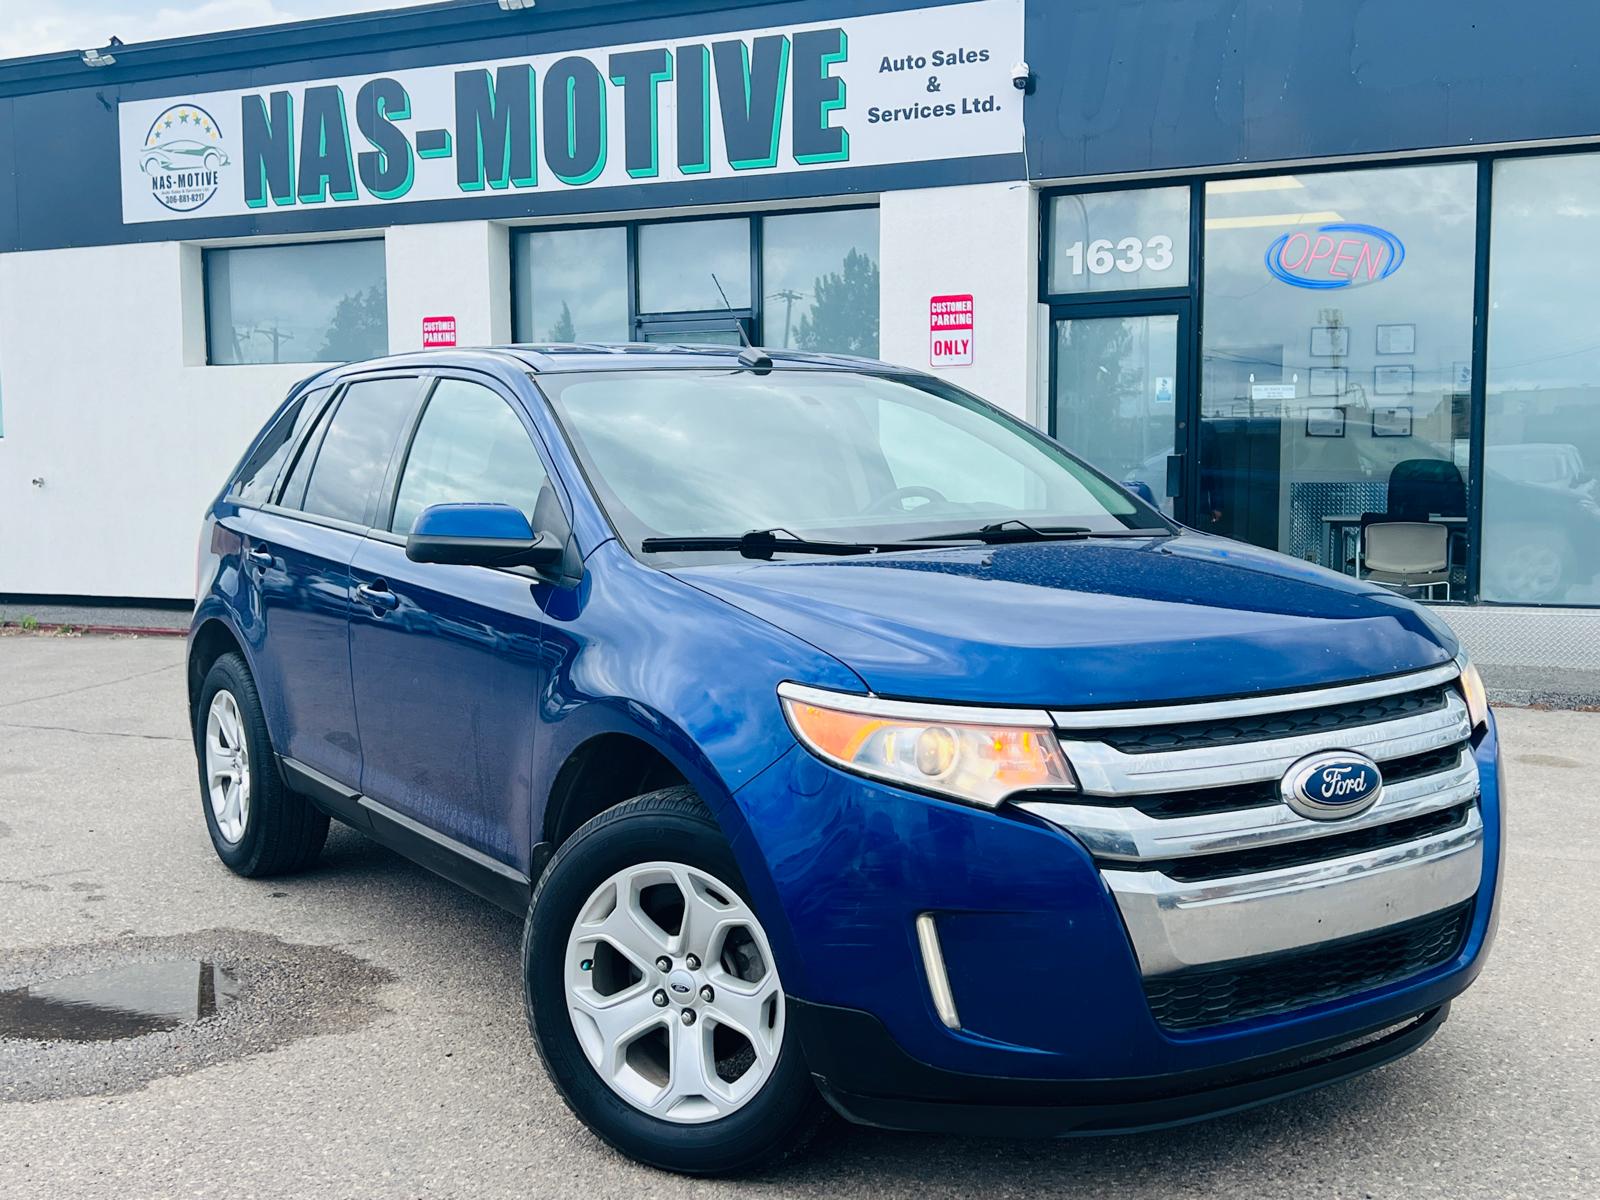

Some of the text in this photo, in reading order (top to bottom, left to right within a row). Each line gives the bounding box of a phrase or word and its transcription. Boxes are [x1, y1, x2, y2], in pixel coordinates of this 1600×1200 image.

[878, 48, 990, 73] Auto Sales
[926, 76, 941, 92] &
[240, 27, 849, 209] NAS-MOTIVE
[867, 95, 1002, 124] Services Ltd.
[152, 171, 218, 190] NAS-MOTIVE
[1066, 235, 1174, 276] 1633
[1281, 232, 1384, 281] OPEN
[931, 301, 972, 313] CUSTOMER
[424, 321, 455, 331] CUSTOMER
[931, 313, 972, 326] PARKING
[424, 332, 455, 343] PARKING
[934, 339, 969, 356] ONLY
[1321, 766, 1367, 798] Ford
